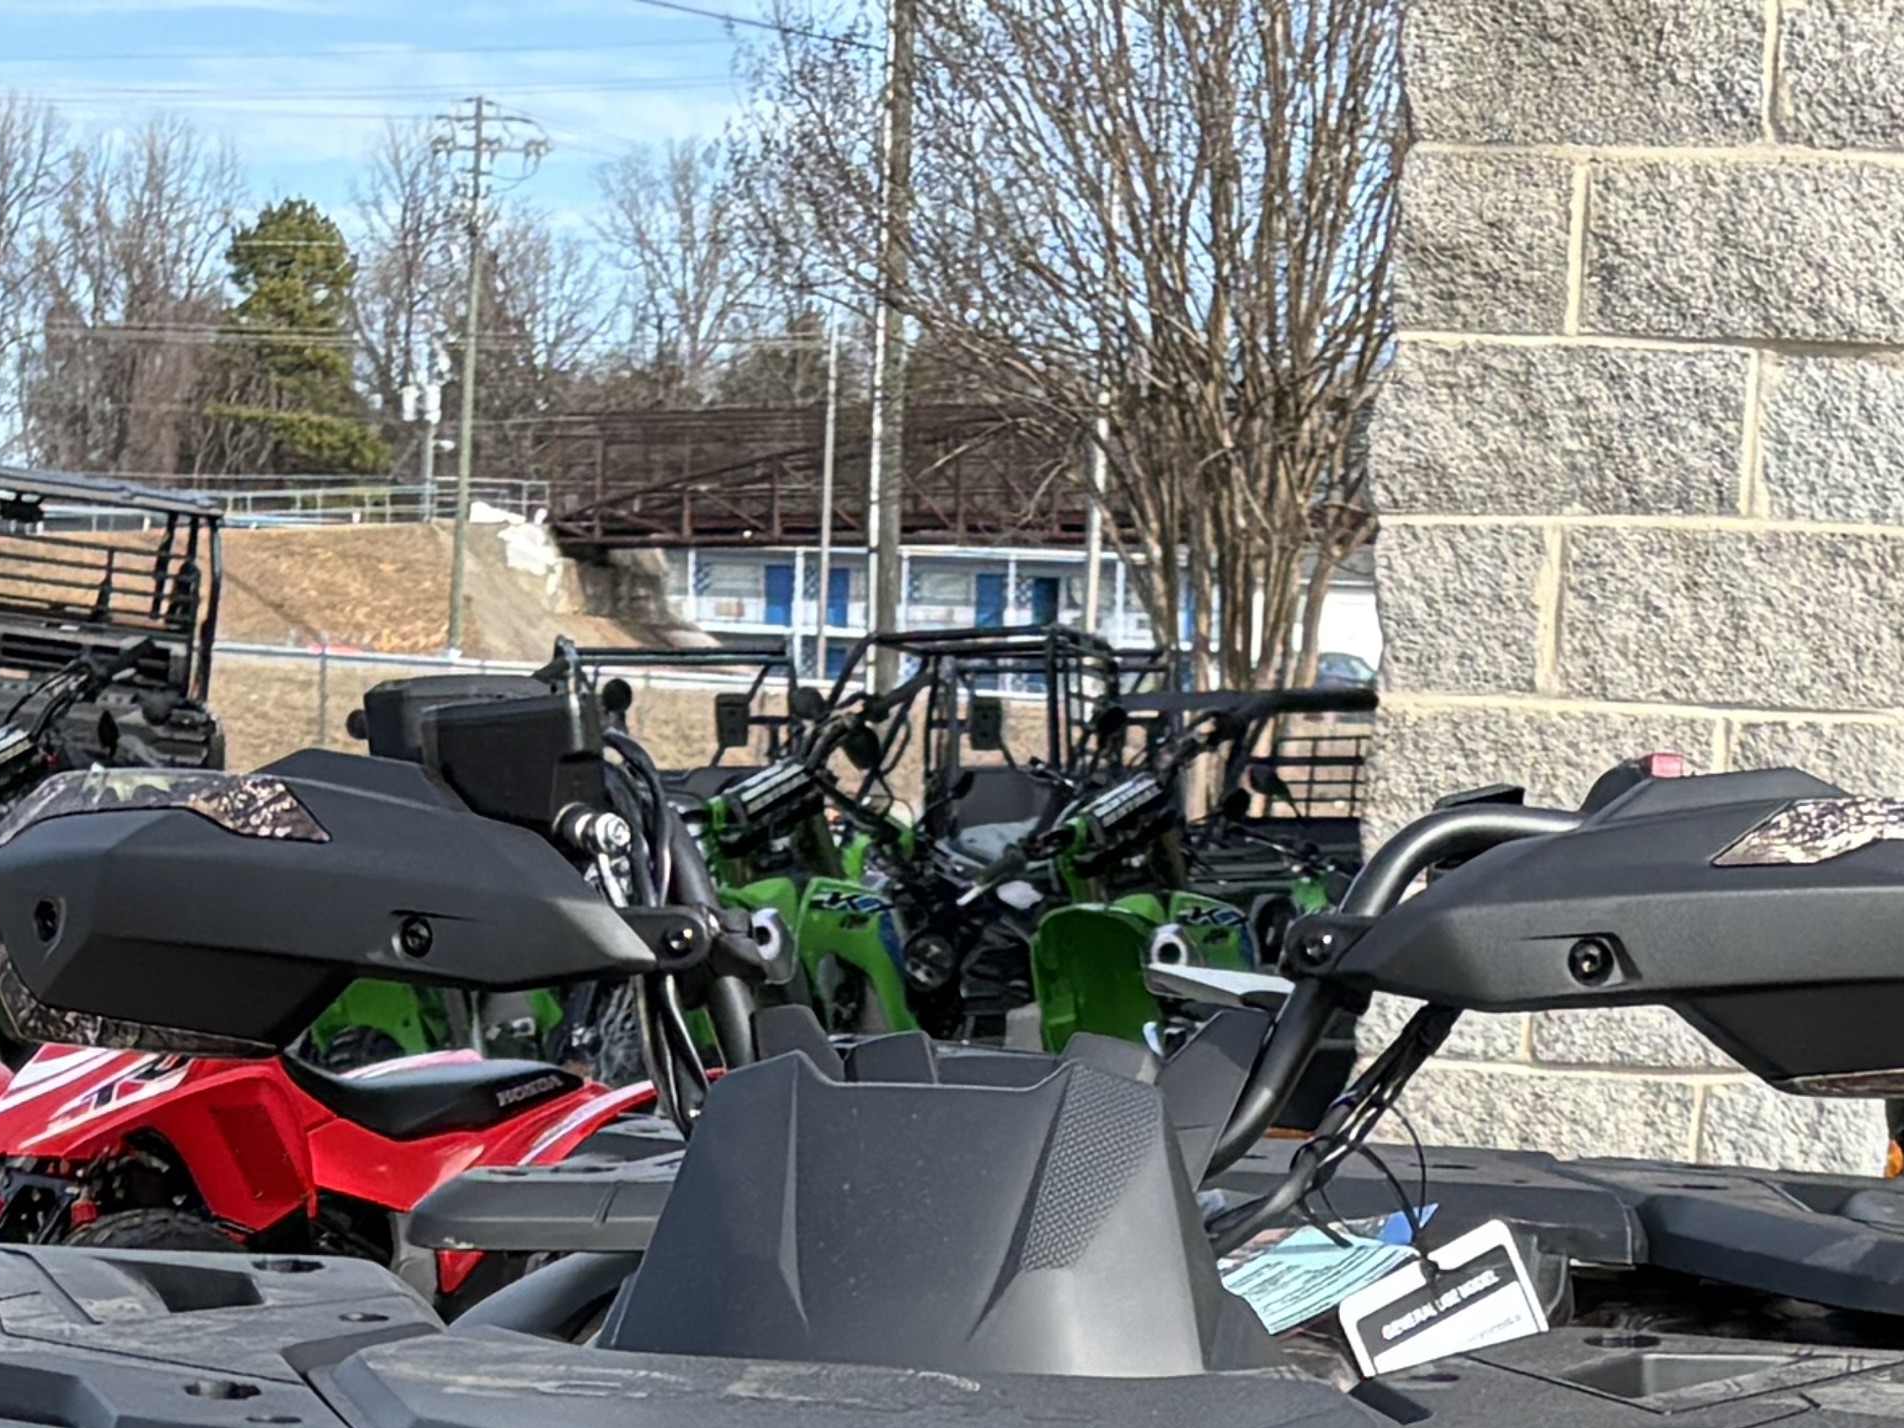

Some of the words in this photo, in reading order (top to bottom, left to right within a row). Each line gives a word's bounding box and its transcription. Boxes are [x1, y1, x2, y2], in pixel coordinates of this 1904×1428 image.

[496, 1074, 564, 1107] HONDA
[1382, 1302, 1438, 1340] GENERAL
[1457, 1269, 1500, 1299] MODEL
